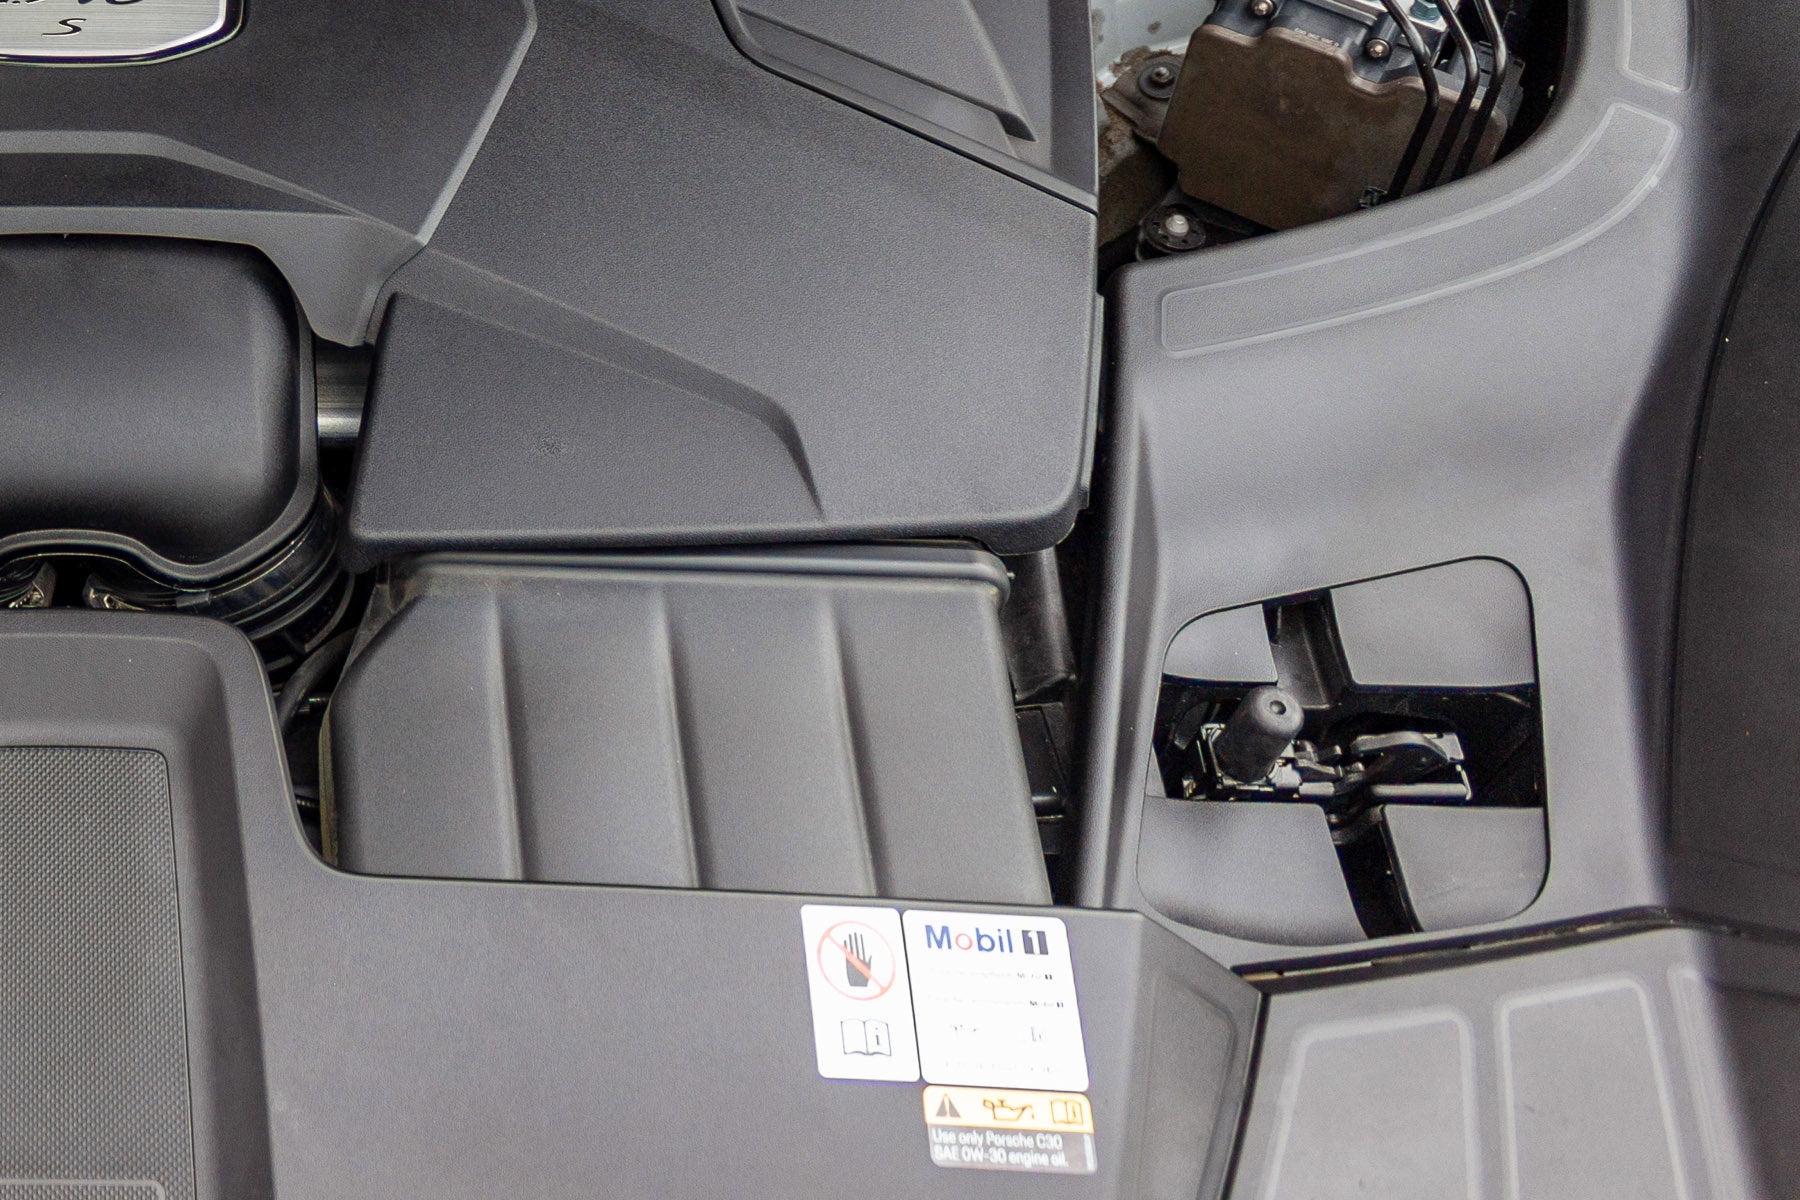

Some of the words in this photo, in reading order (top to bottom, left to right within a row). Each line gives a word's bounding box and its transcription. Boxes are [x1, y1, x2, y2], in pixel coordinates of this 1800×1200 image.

[41, 17, 87, 37] S
[924, 924, 1014, 954] Mobil
[1021, 929, 1049, 956] 1
[931, 1127, 956, 1144] Use
[958, 1129, 984, 1146] only
[985, 1130, 1035, 1148] Porsche
[933, 1144, 959, 1161] SAE
[1008, 1150, 1049, 1168] engine
